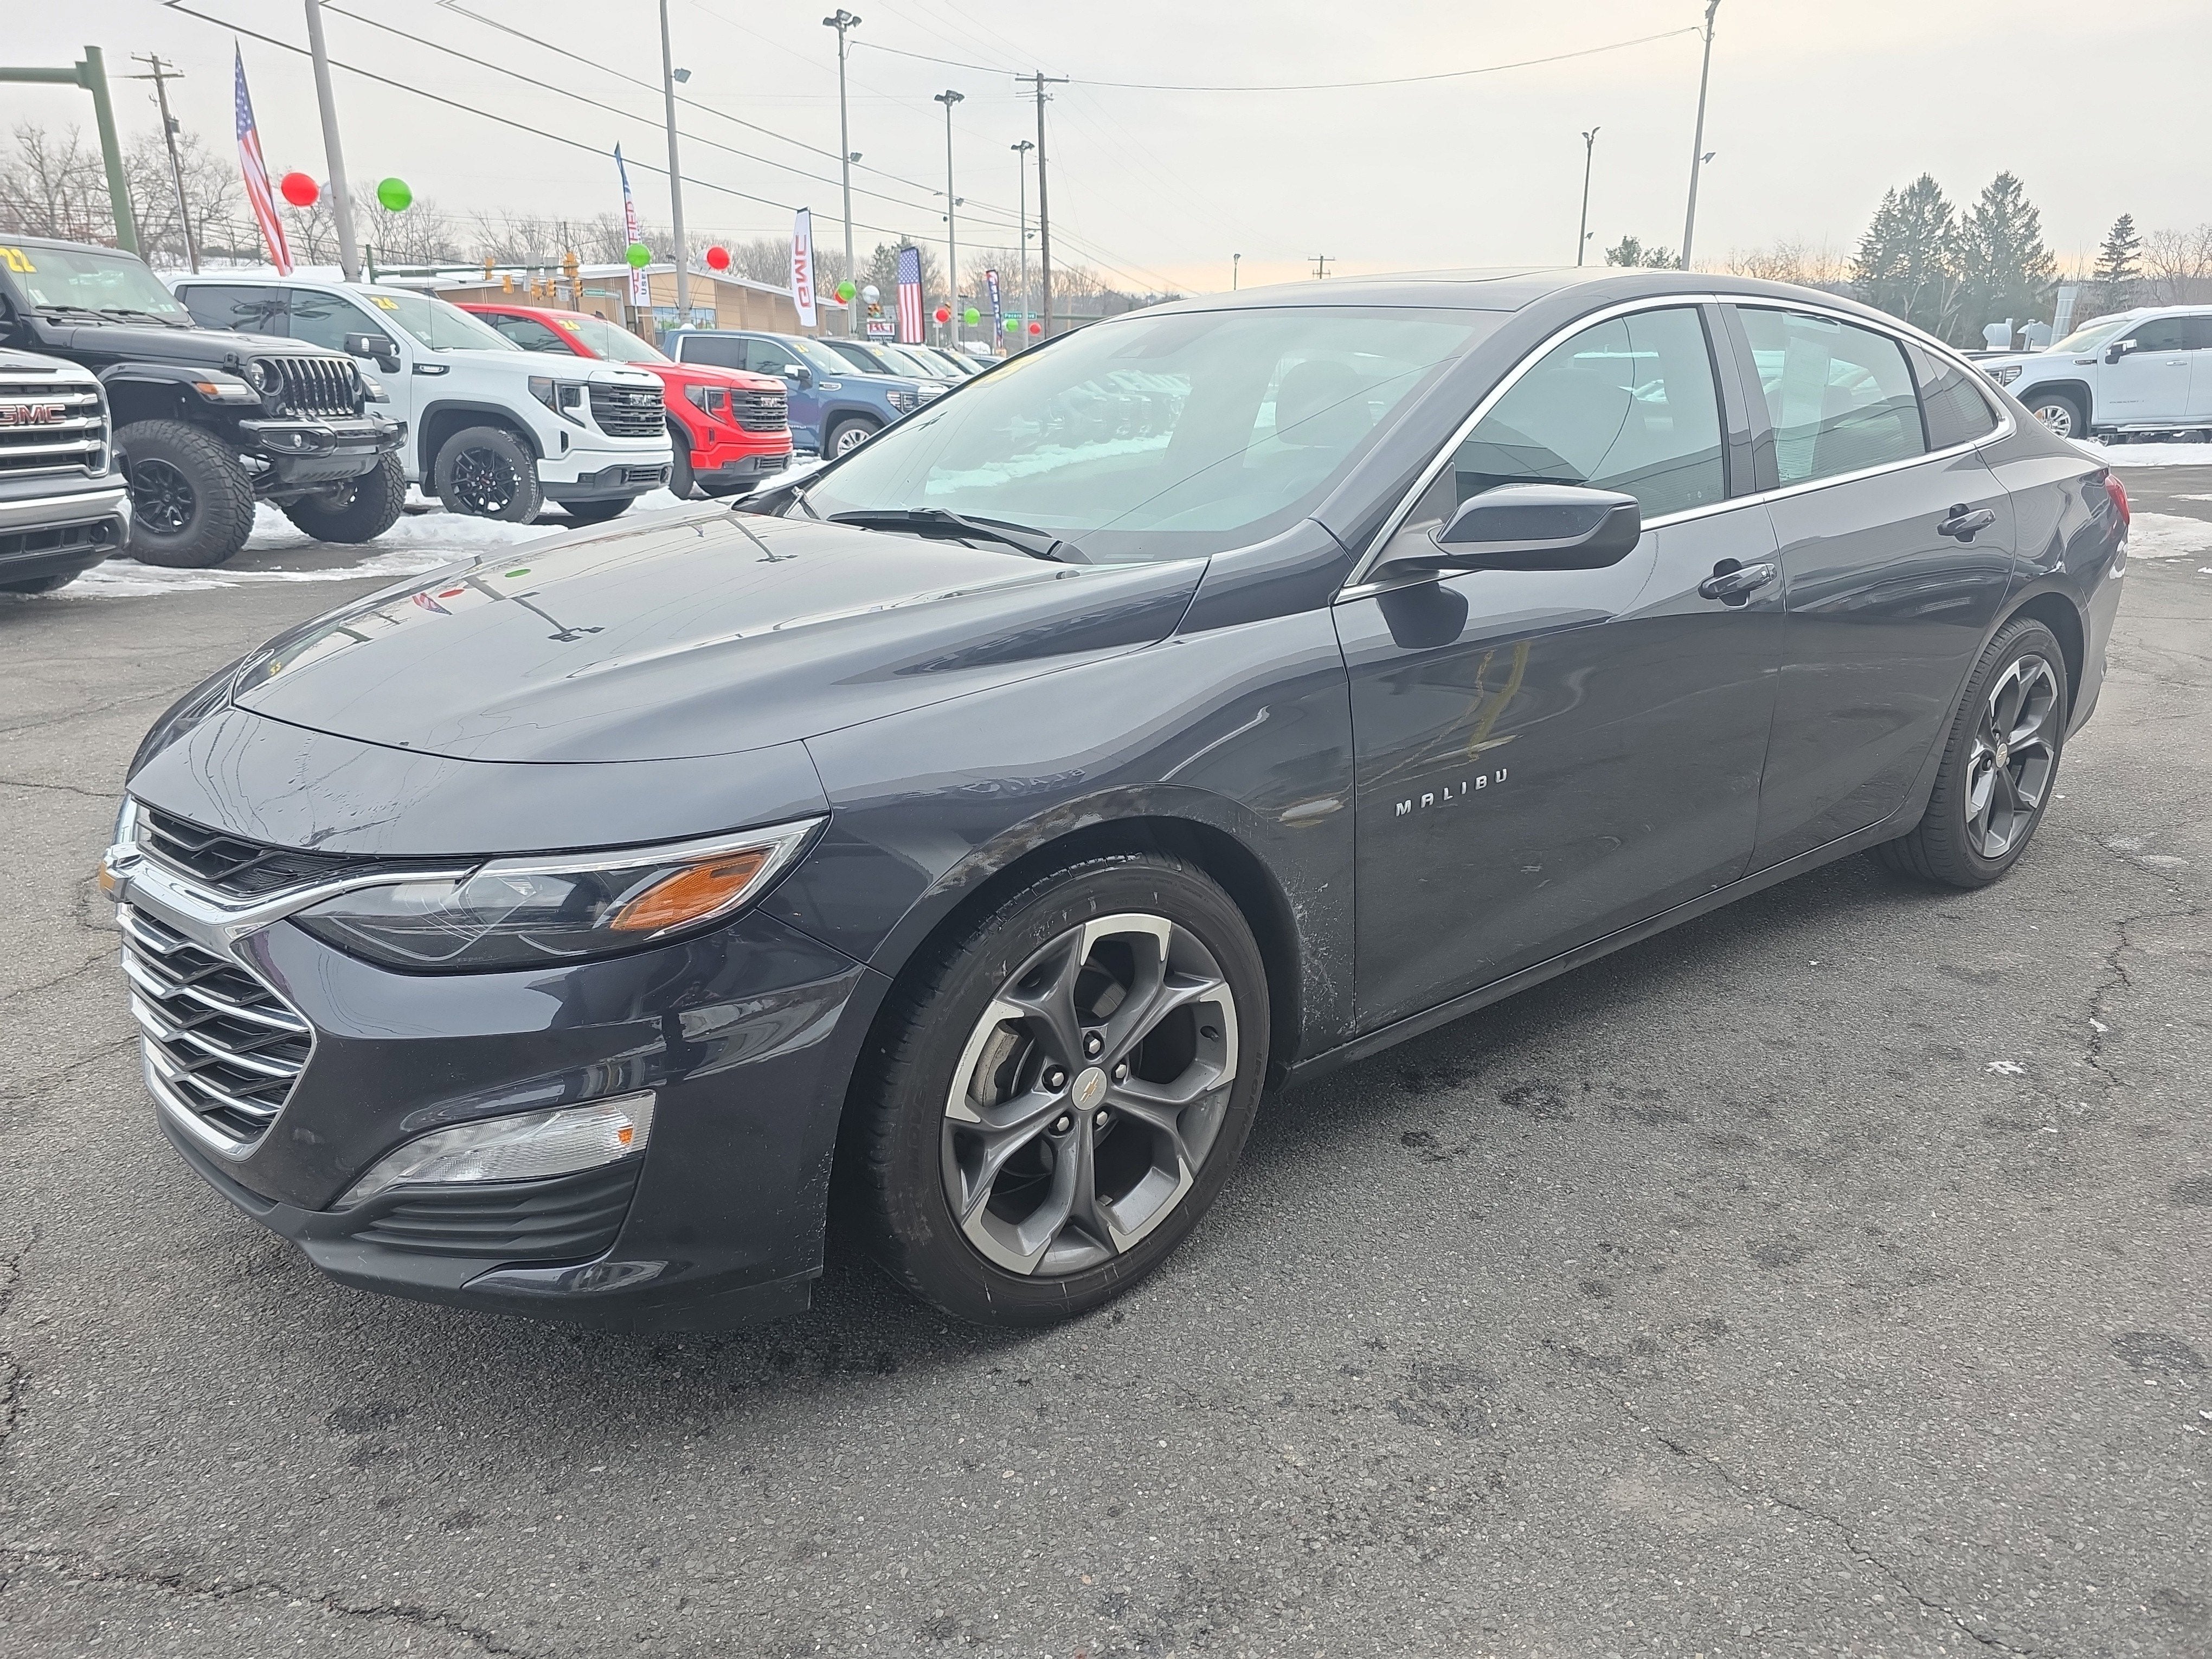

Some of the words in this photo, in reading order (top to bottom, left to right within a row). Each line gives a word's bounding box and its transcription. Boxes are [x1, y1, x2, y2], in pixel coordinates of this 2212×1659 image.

[626, 201, 639, 294] CEFIED
[0, 404, 66, 425] GMC
[1395, 768, 1507, 817] MALIBU
